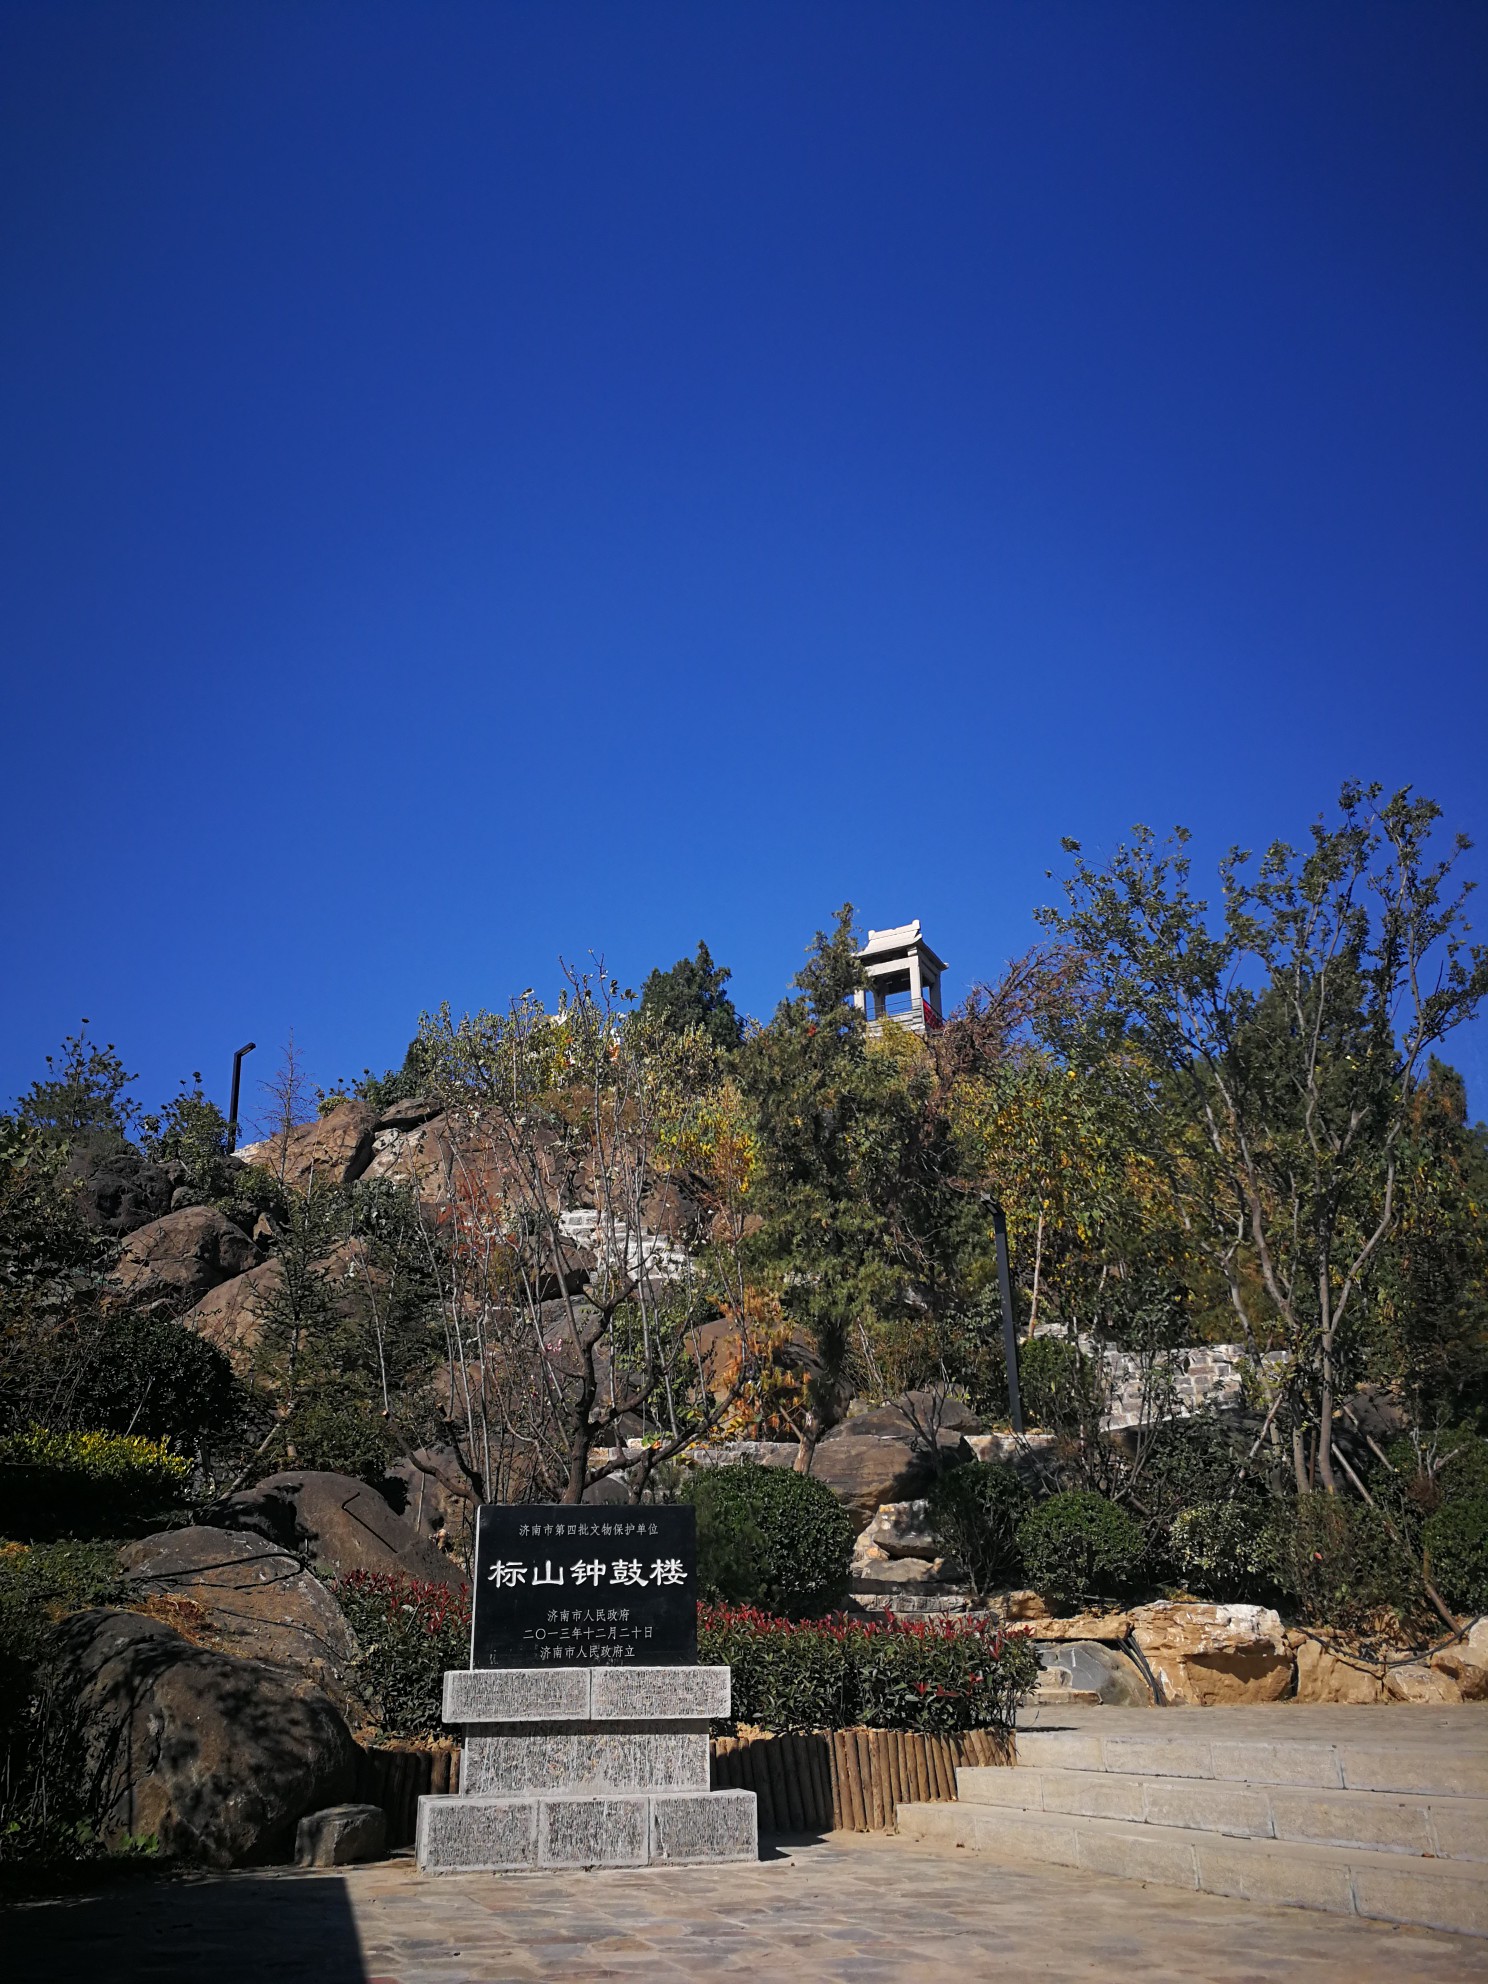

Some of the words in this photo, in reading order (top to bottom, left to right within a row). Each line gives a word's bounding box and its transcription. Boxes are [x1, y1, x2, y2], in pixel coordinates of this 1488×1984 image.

[518, 1523, 659, 1537] 济南市第四批文物保护单位
[487, 1558, 688, 1588] 标山钟鼓楼
[547, 1609, 630, 1622] 济南市人民政府
[540, 1645, 635, 1659] 济南市人民政府立
